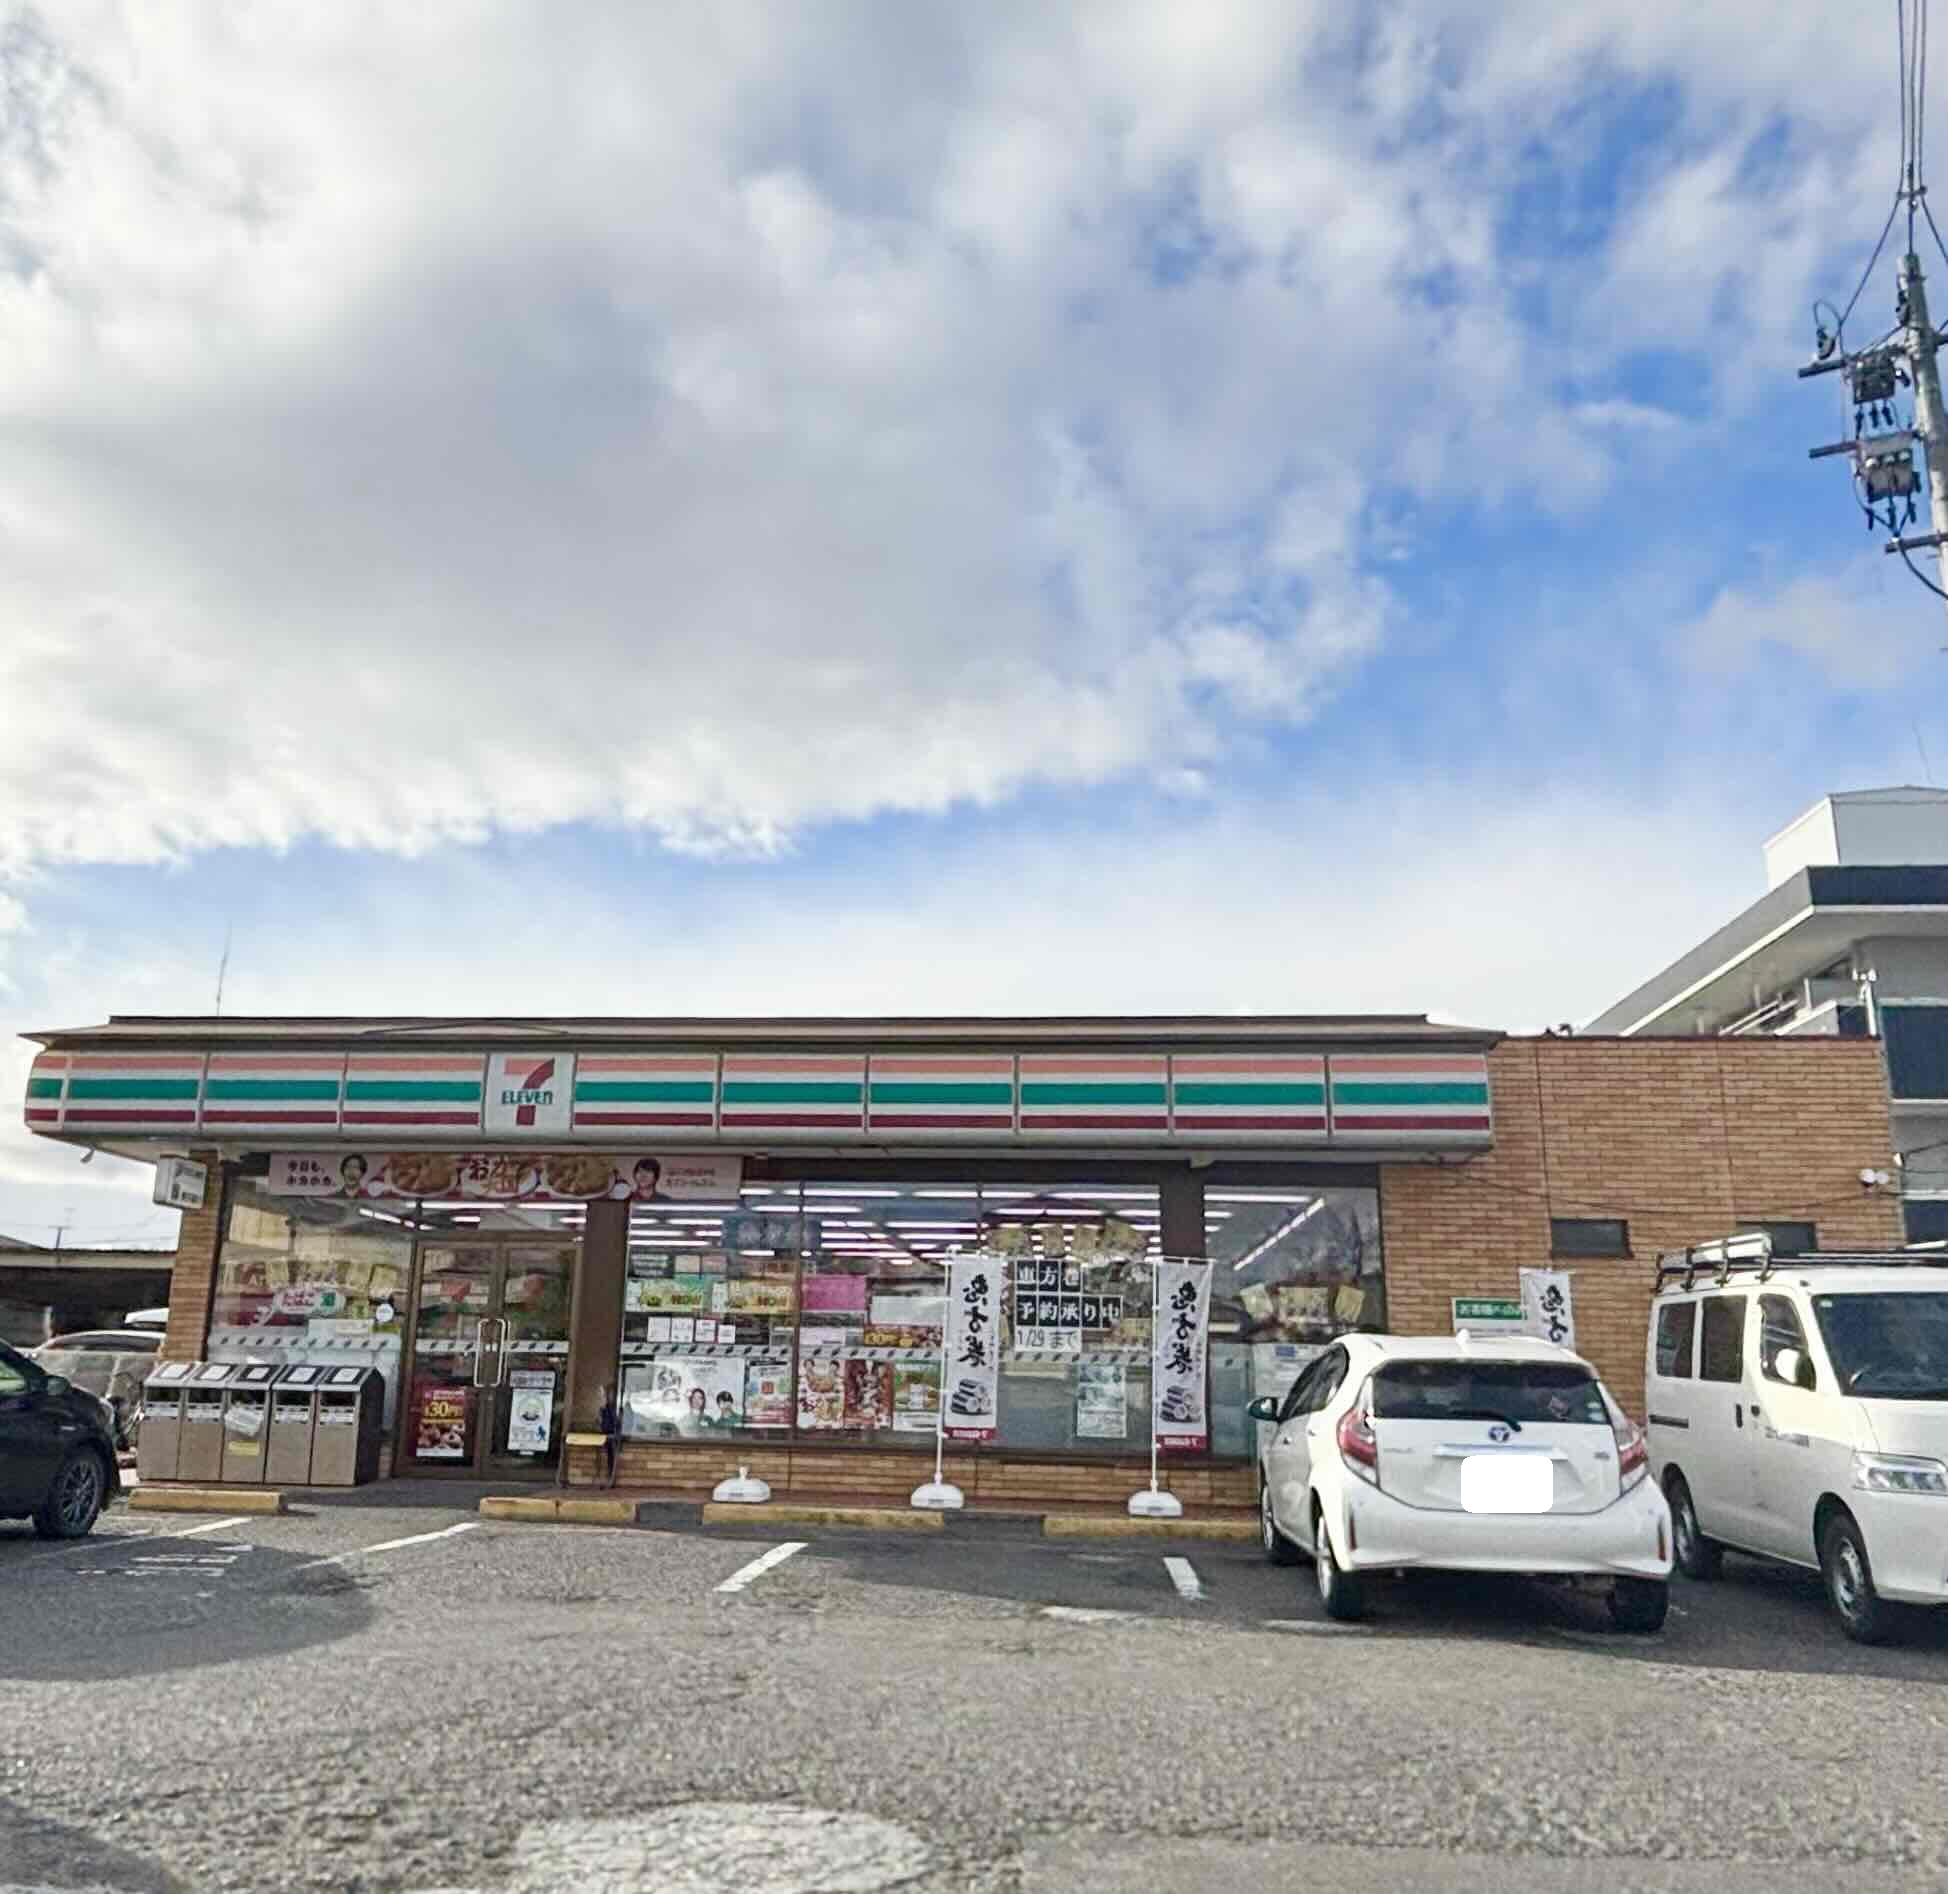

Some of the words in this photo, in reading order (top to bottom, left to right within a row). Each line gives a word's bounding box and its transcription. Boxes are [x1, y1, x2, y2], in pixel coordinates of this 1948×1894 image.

[504, 1057, 555, 1126] 7
[1018, 1301, 1120, 1322] 予約承り中
